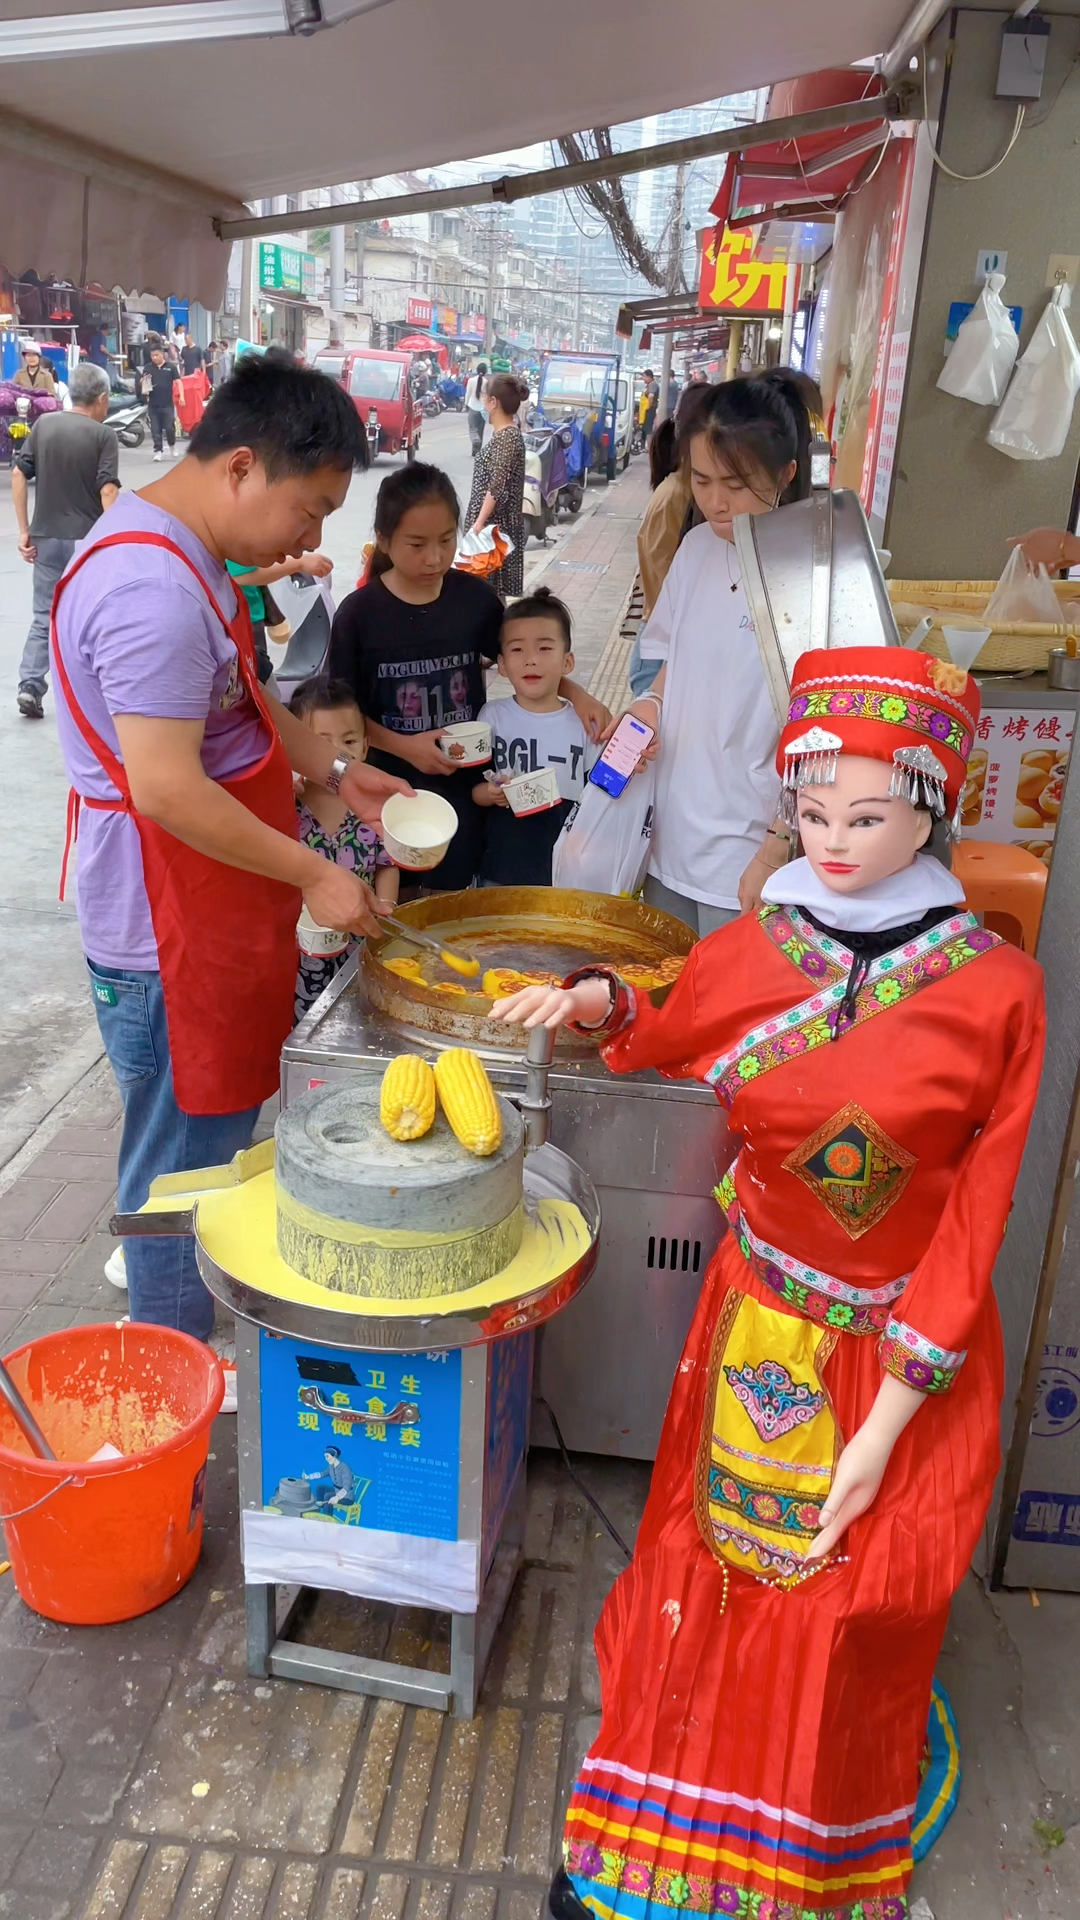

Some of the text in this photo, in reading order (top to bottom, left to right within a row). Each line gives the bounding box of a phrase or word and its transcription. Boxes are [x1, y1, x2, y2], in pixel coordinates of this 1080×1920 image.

[976, 714, 1073, 743] 香烤馒
[297, 1411, 421, 1448] 现做现卖
